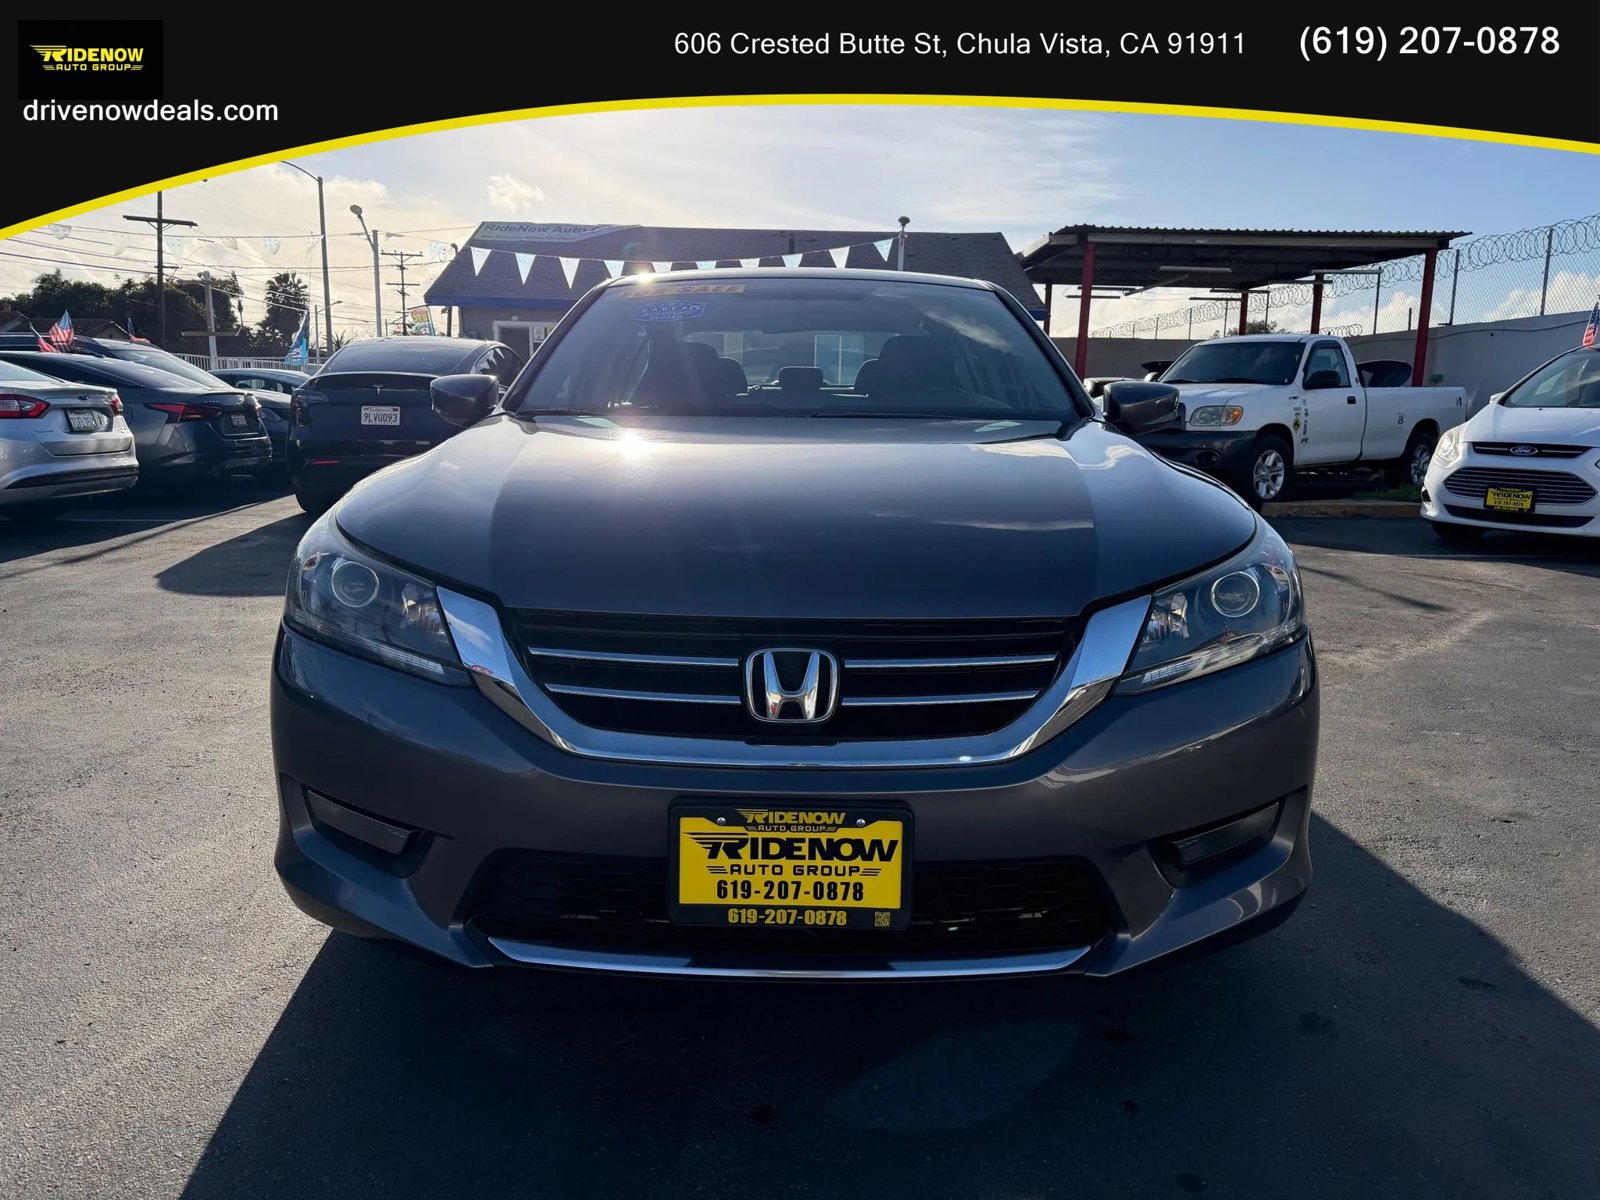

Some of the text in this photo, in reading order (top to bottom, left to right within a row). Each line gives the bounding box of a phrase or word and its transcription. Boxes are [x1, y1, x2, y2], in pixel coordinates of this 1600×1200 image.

[484, 224, 550, 233] RideNow
[552, 225, 588, 233] Auto
[736, 809, 846, 825] RIDENOW
[757, 824, 787, 832] AUTO
[683, 832, 899, 862] RIDENOW
[730, 864, 860, 877] AUTO GROUP
[717, 879, 864, 901] 619-207-0878
[728, 908, 847, 926] 619-207-0878
